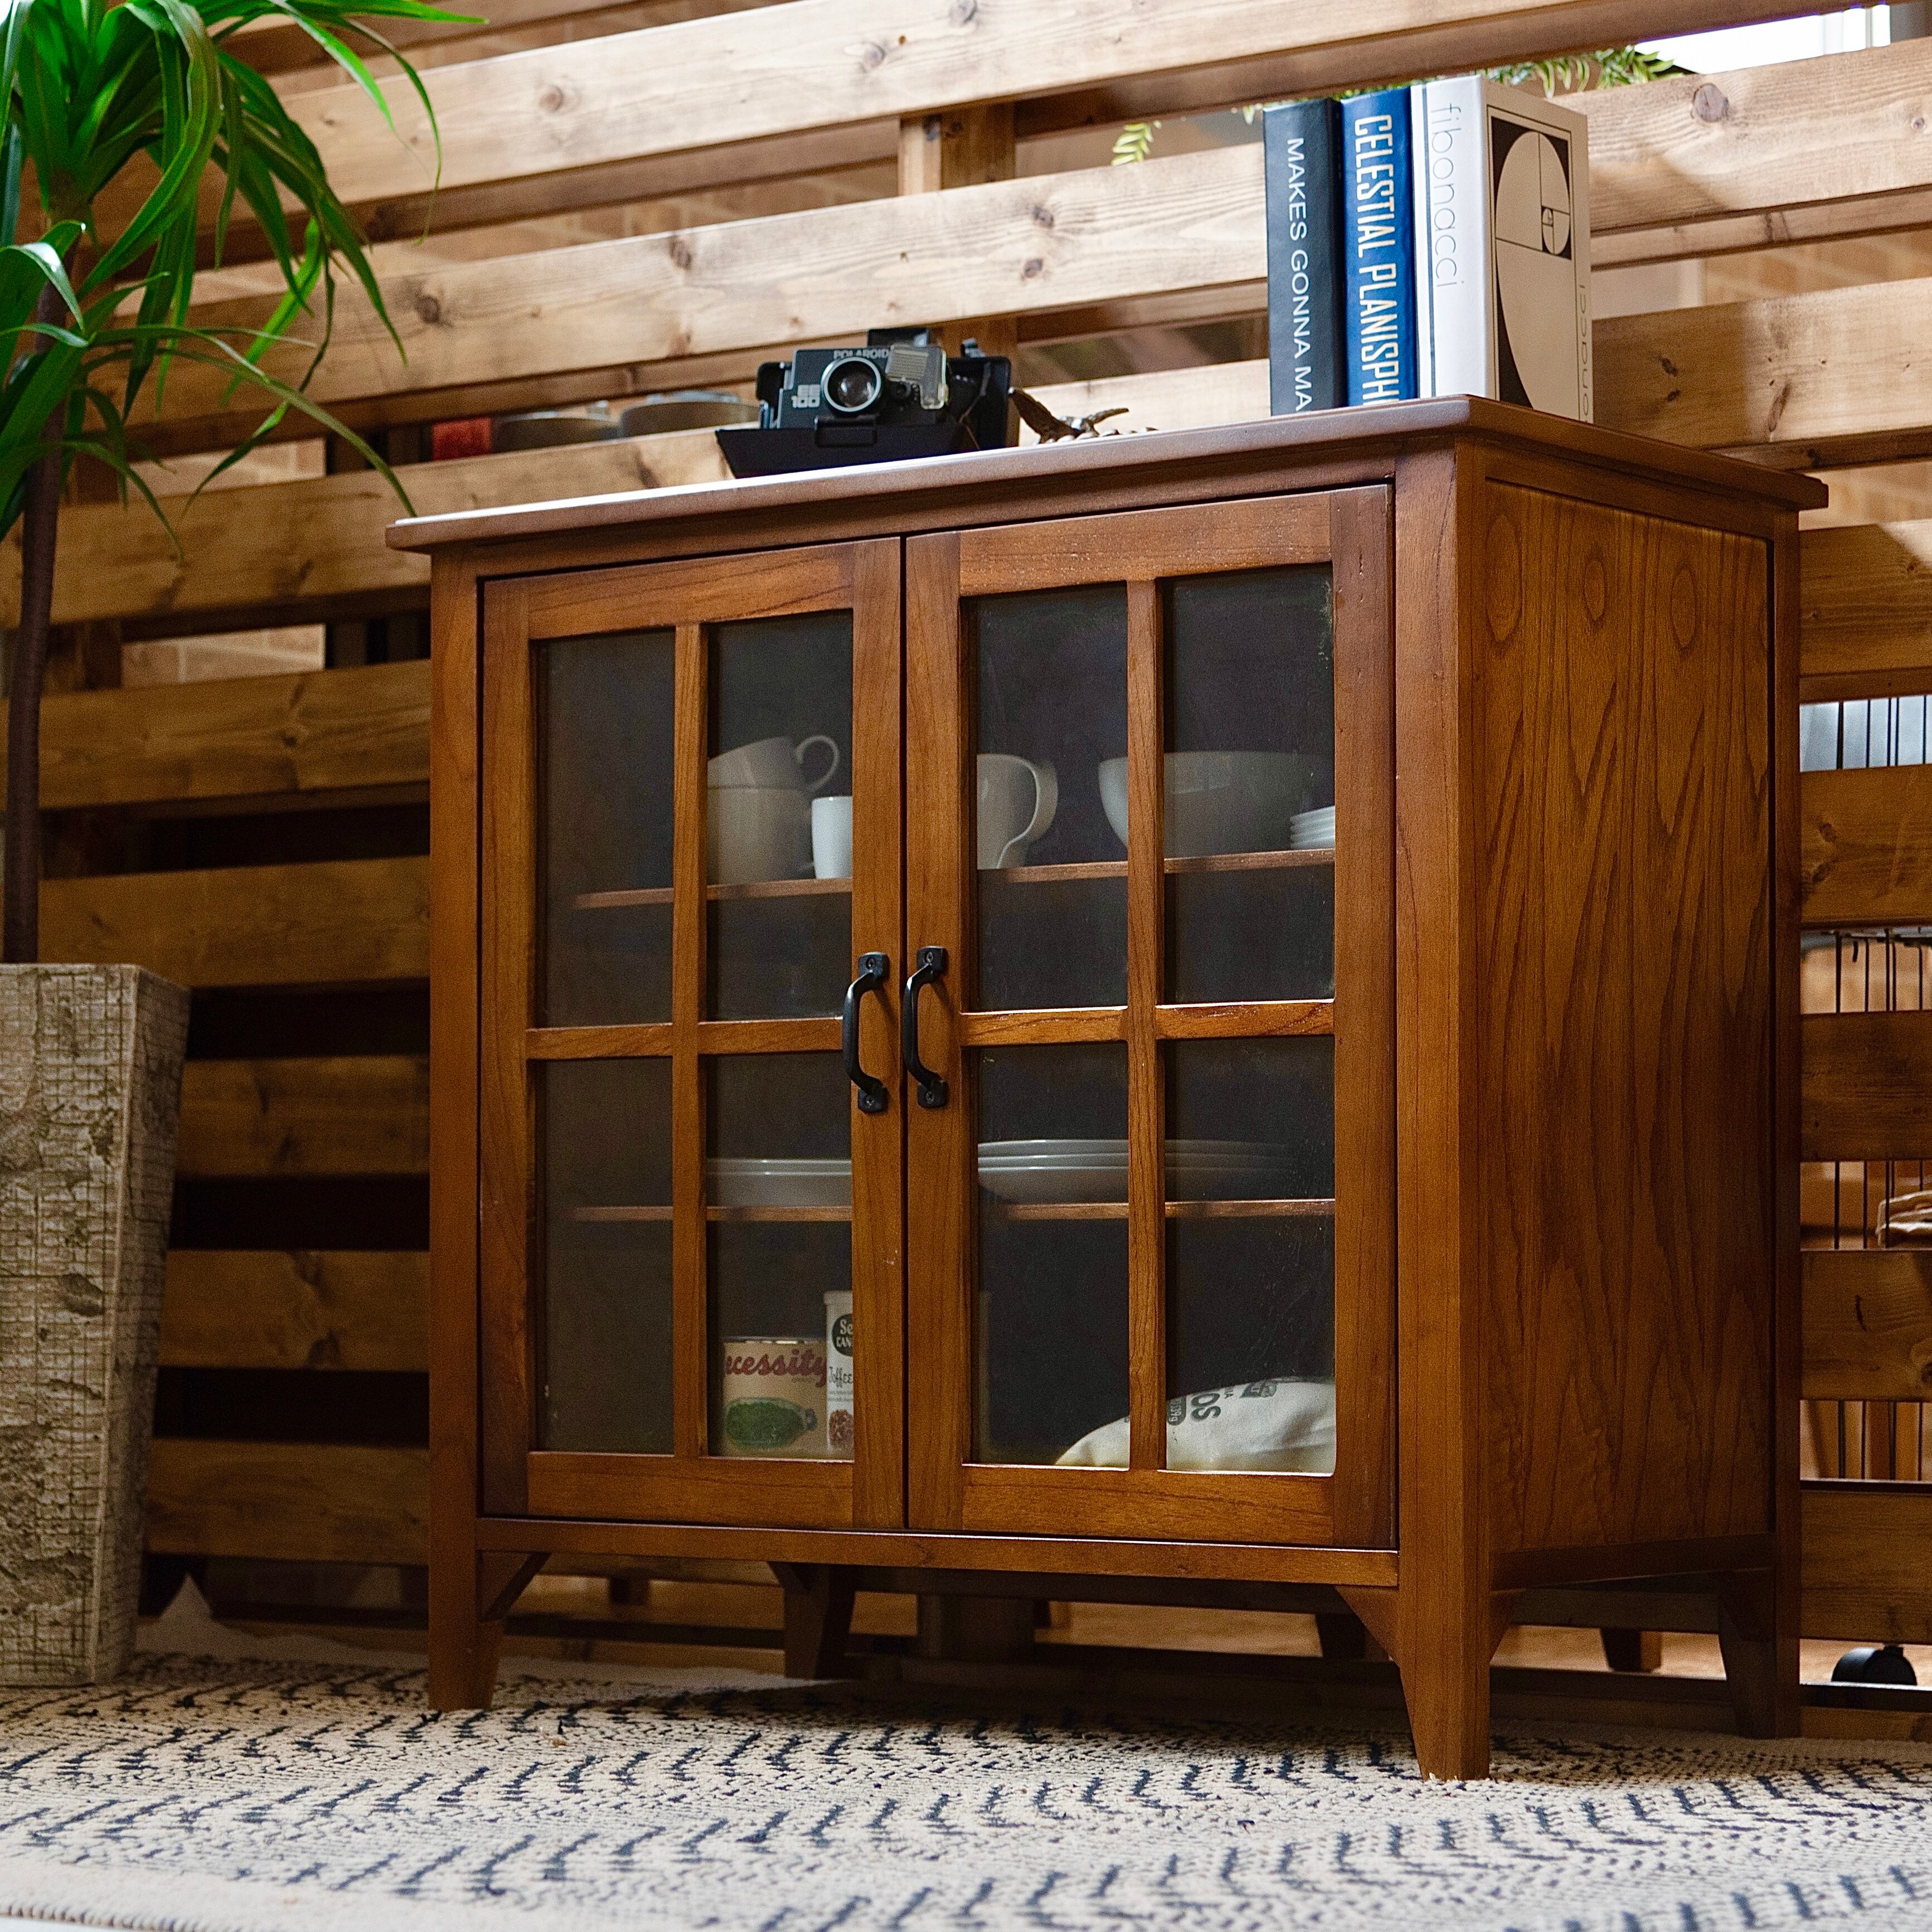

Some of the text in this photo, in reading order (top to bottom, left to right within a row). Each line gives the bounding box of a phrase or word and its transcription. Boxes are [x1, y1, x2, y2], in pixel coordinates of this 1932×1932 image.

[1287, 137, 1308, 241] MAKES
[1355, 114, 1395, 258] CELESTIAL
[1431, 103, 1465, 288] fibonacci
[833, 348, 889, 360] POLAROID
[1291, 250, 1311, 359] GONNA
[792, 395, 820, 409] 100
